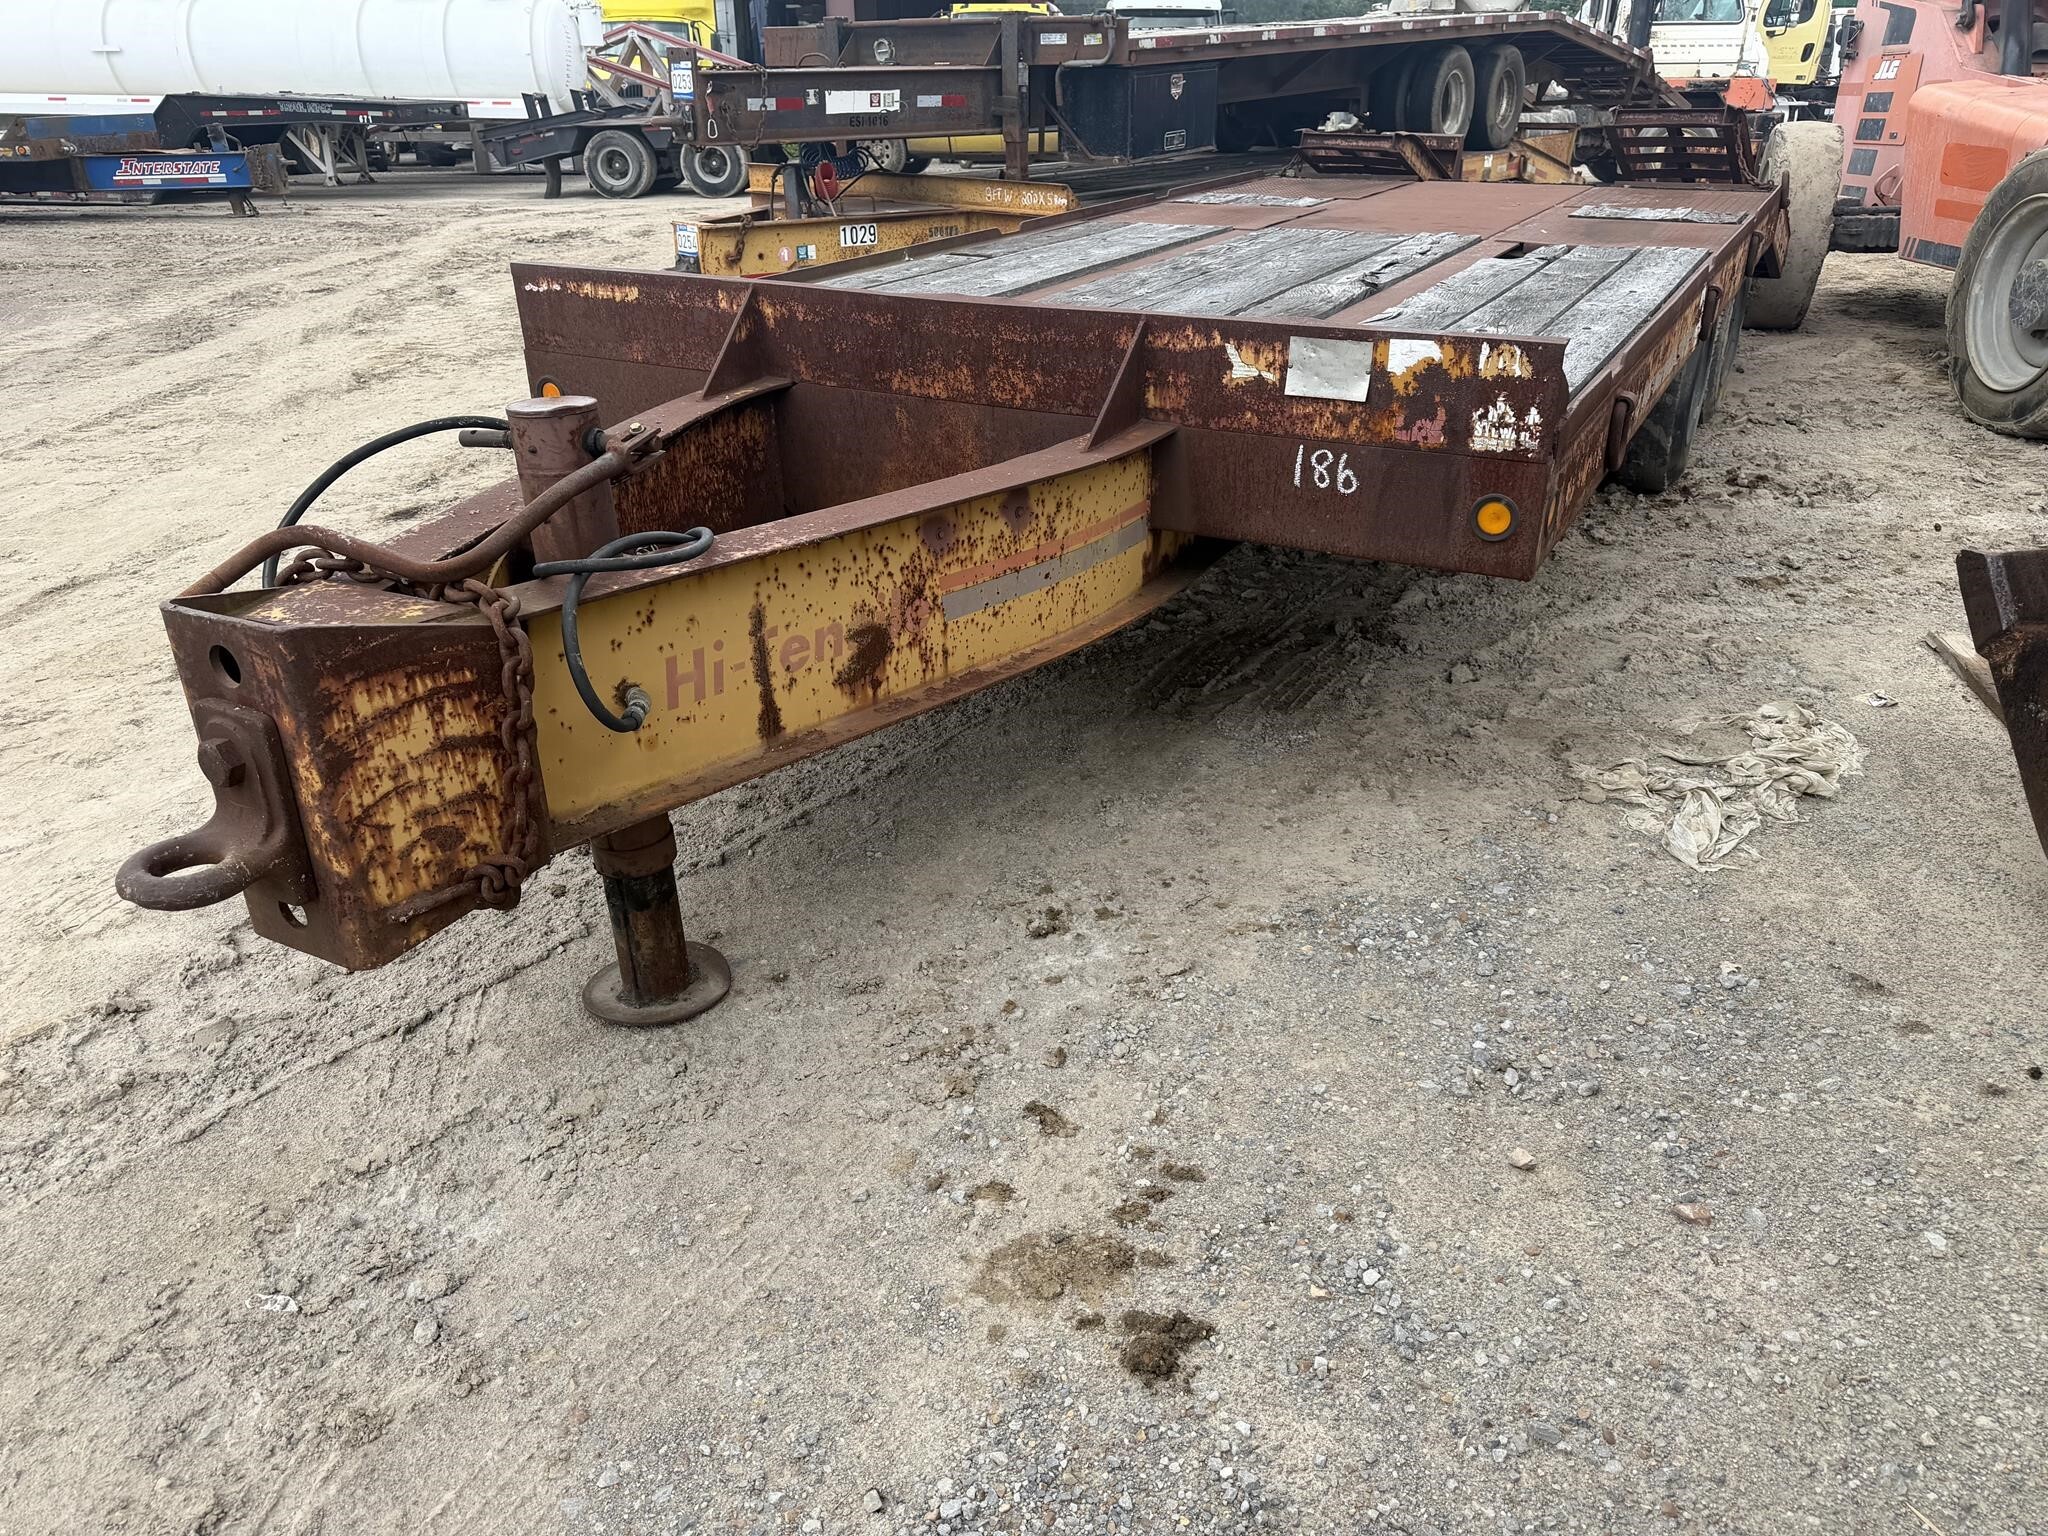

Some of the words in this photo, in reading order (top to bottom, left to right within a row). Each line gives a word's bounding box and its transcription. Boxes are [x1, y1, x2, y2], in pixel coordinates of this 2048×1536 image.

[1873, 60, 1901, 80] JLG
[673, 73, 692, 90] 0253
[116, 158, 221, 176] INTERSTATE
[678, 234, 697, 250] 0254
[841, 225, 876, 245] 1029
[1293, 444, 1360, 496] 186
